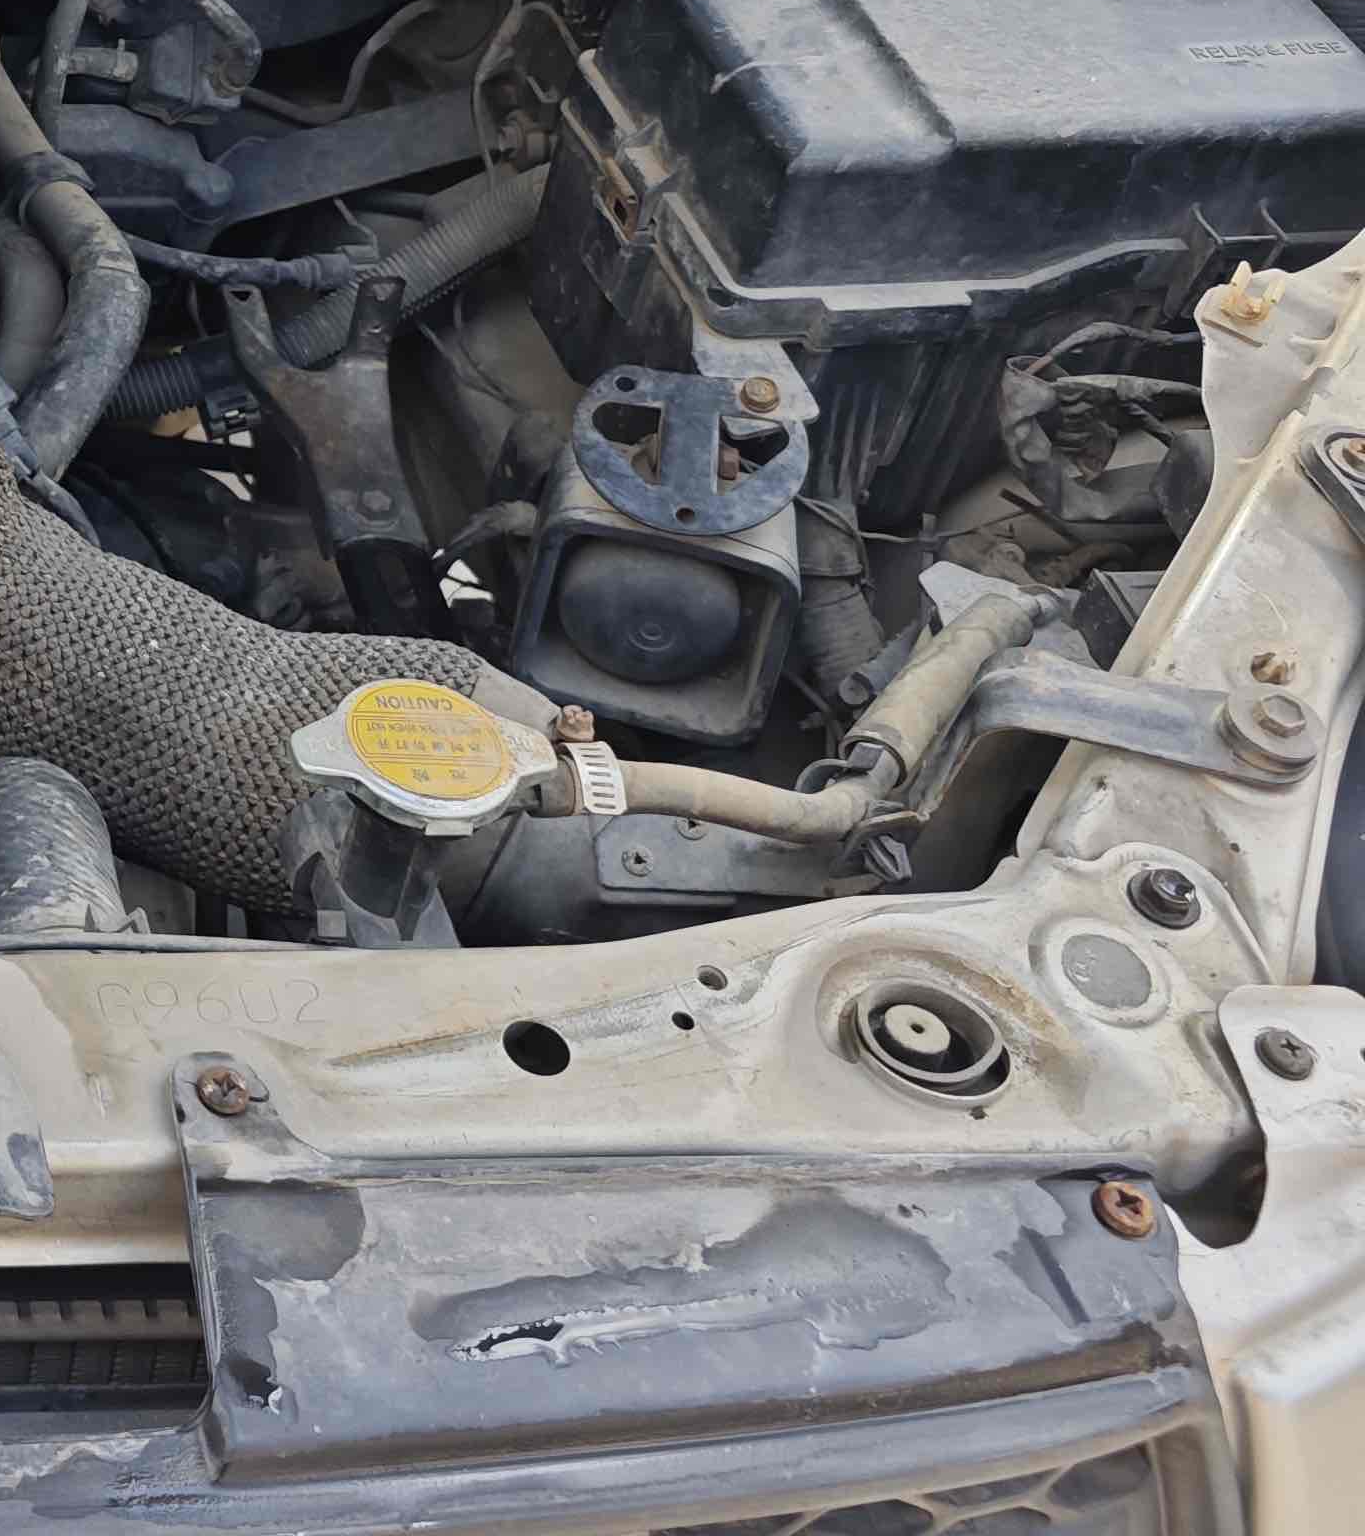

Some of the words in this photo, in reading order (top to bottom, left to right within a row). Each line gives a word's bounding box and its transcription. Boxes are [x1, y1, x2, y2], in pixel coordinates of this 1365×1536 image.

[1187, 43, 1263, 61] RELAY
[1283, 39, 1348, 58] FUSE
[374, 695, 454, 712] CAUTION
